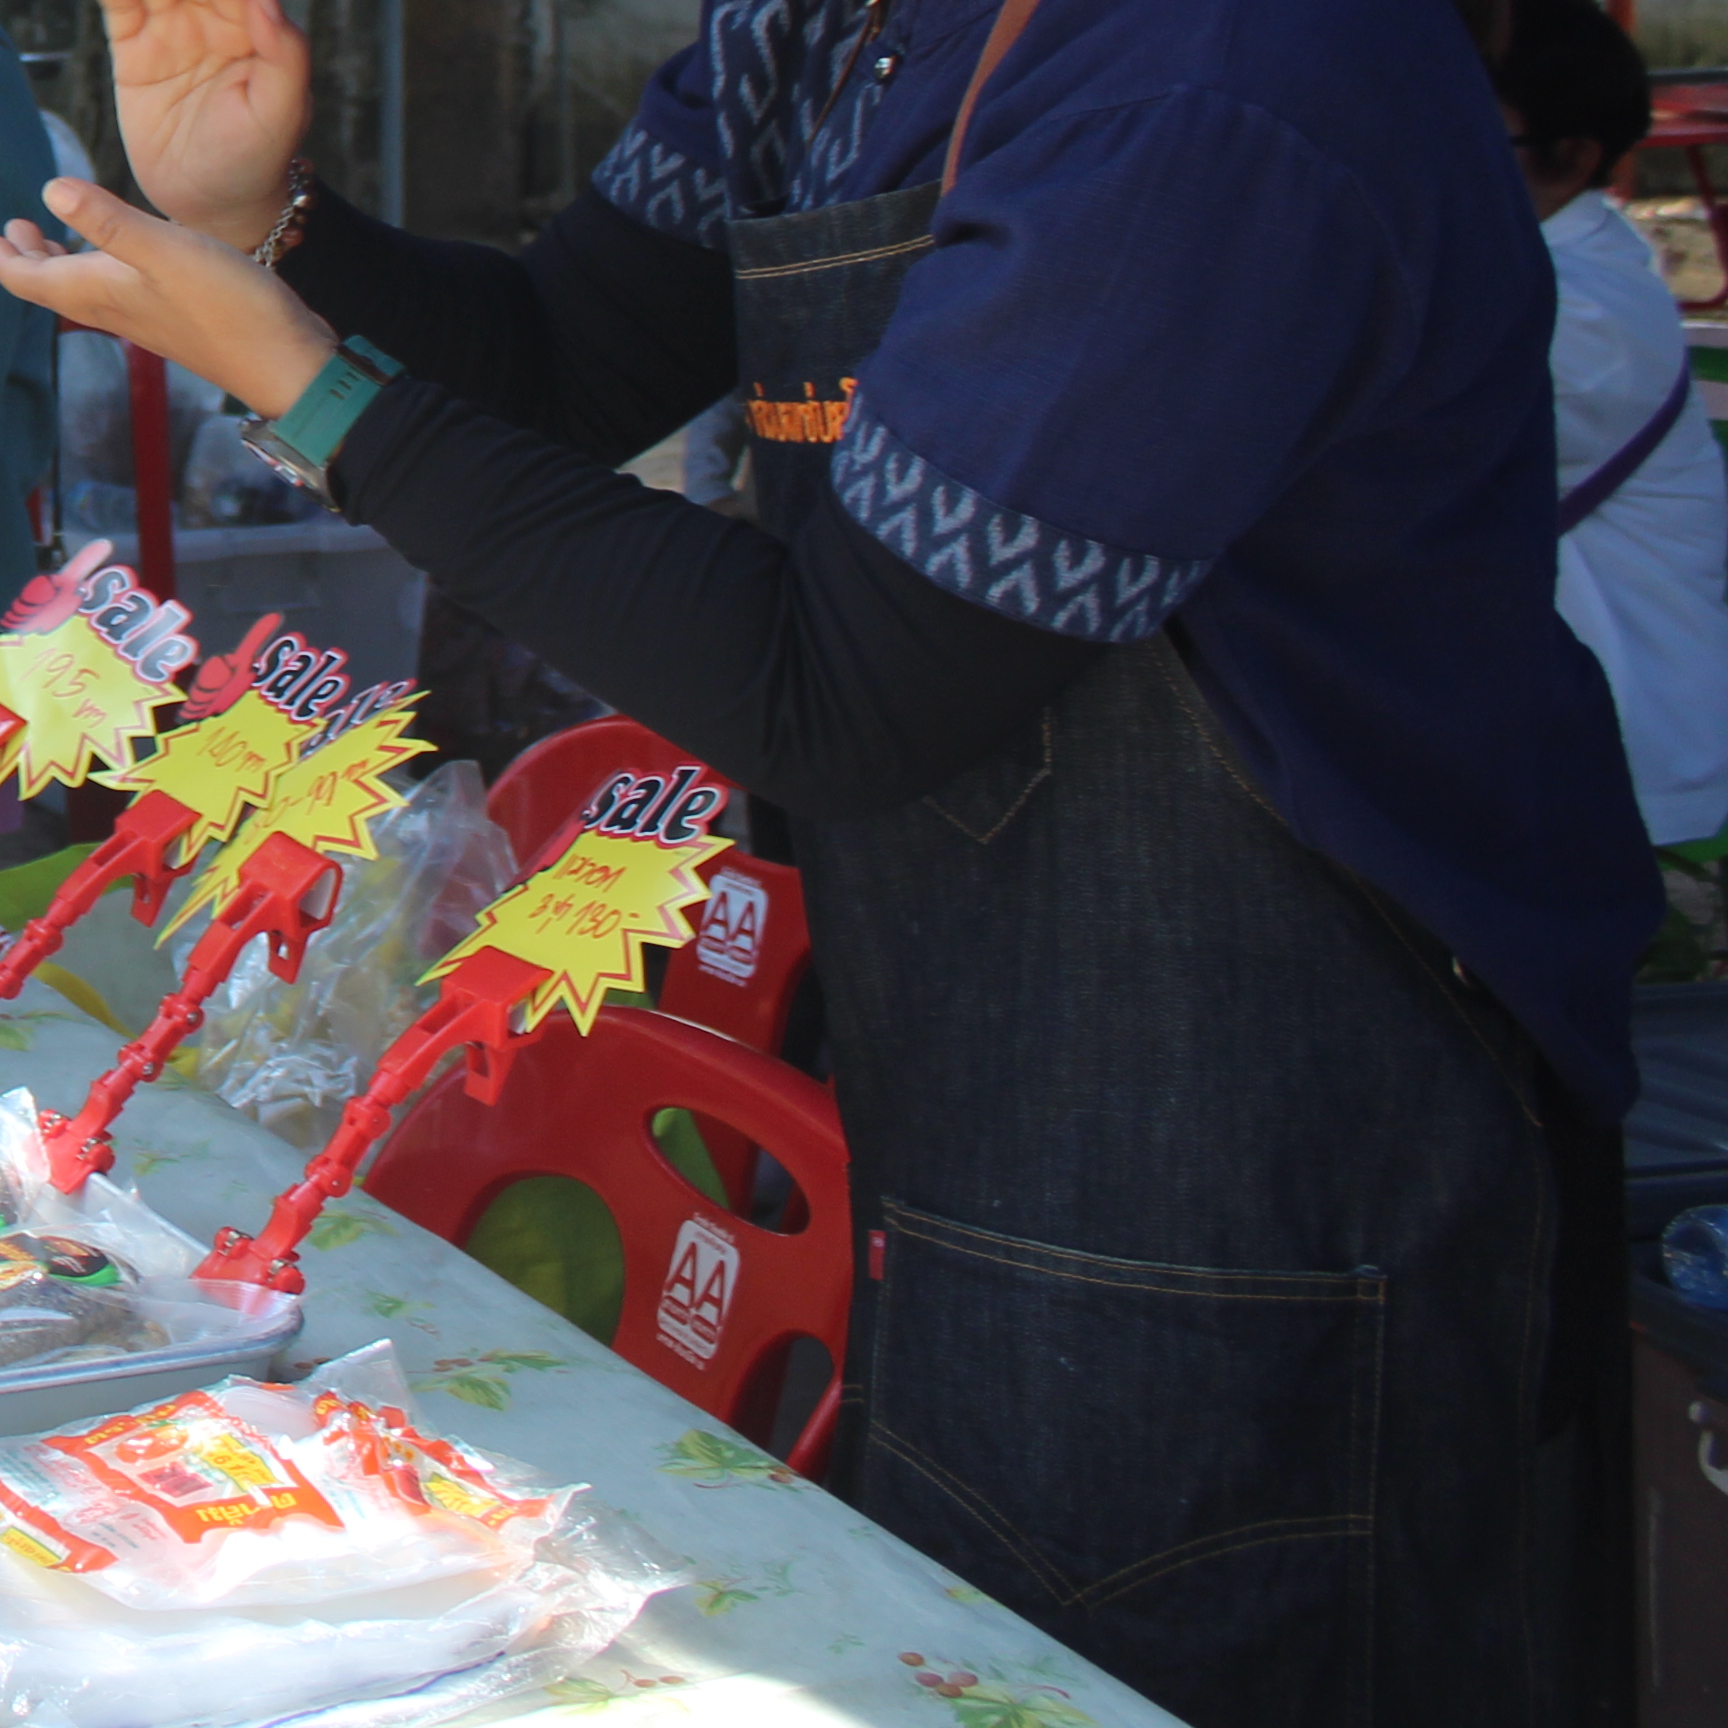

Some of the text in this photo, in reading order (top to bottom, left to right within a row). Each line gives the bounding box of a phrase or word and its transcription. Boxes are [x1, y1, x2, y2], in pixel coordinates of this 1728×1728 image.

[77, 568, 194, 683] sale
[22, 647, 101, 699] 195
[251, 635, 345, 721] sale
[581, 765, 720, 845] sale
